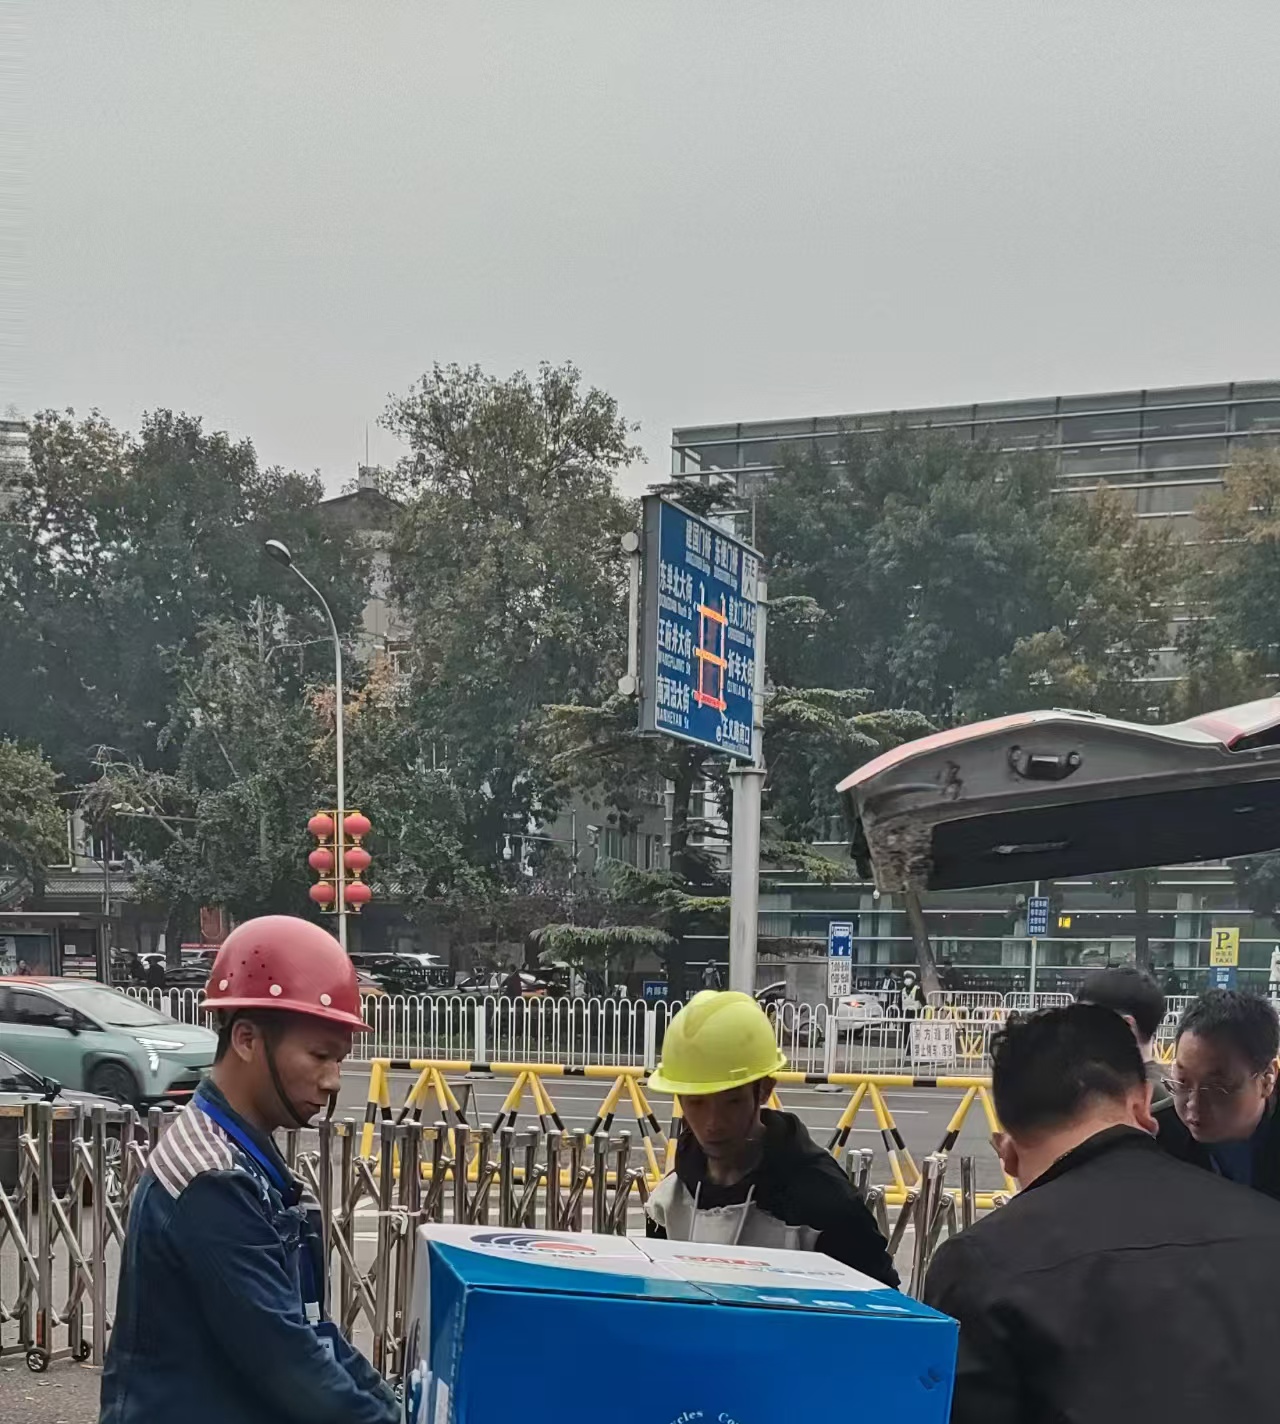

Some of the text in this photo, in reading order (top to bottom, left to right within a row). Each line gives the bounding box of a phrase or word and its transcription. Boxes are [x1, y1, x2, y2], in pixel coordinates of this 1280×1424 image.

[660, 559, 693, 604] 东单北大街
[658, 619, 692, 659] 王府井大街
[657, 673, 690, 714] 南河沿大街
[1215, 931, 1230, 950] P
[832, 983, 848, 995] 工作日
